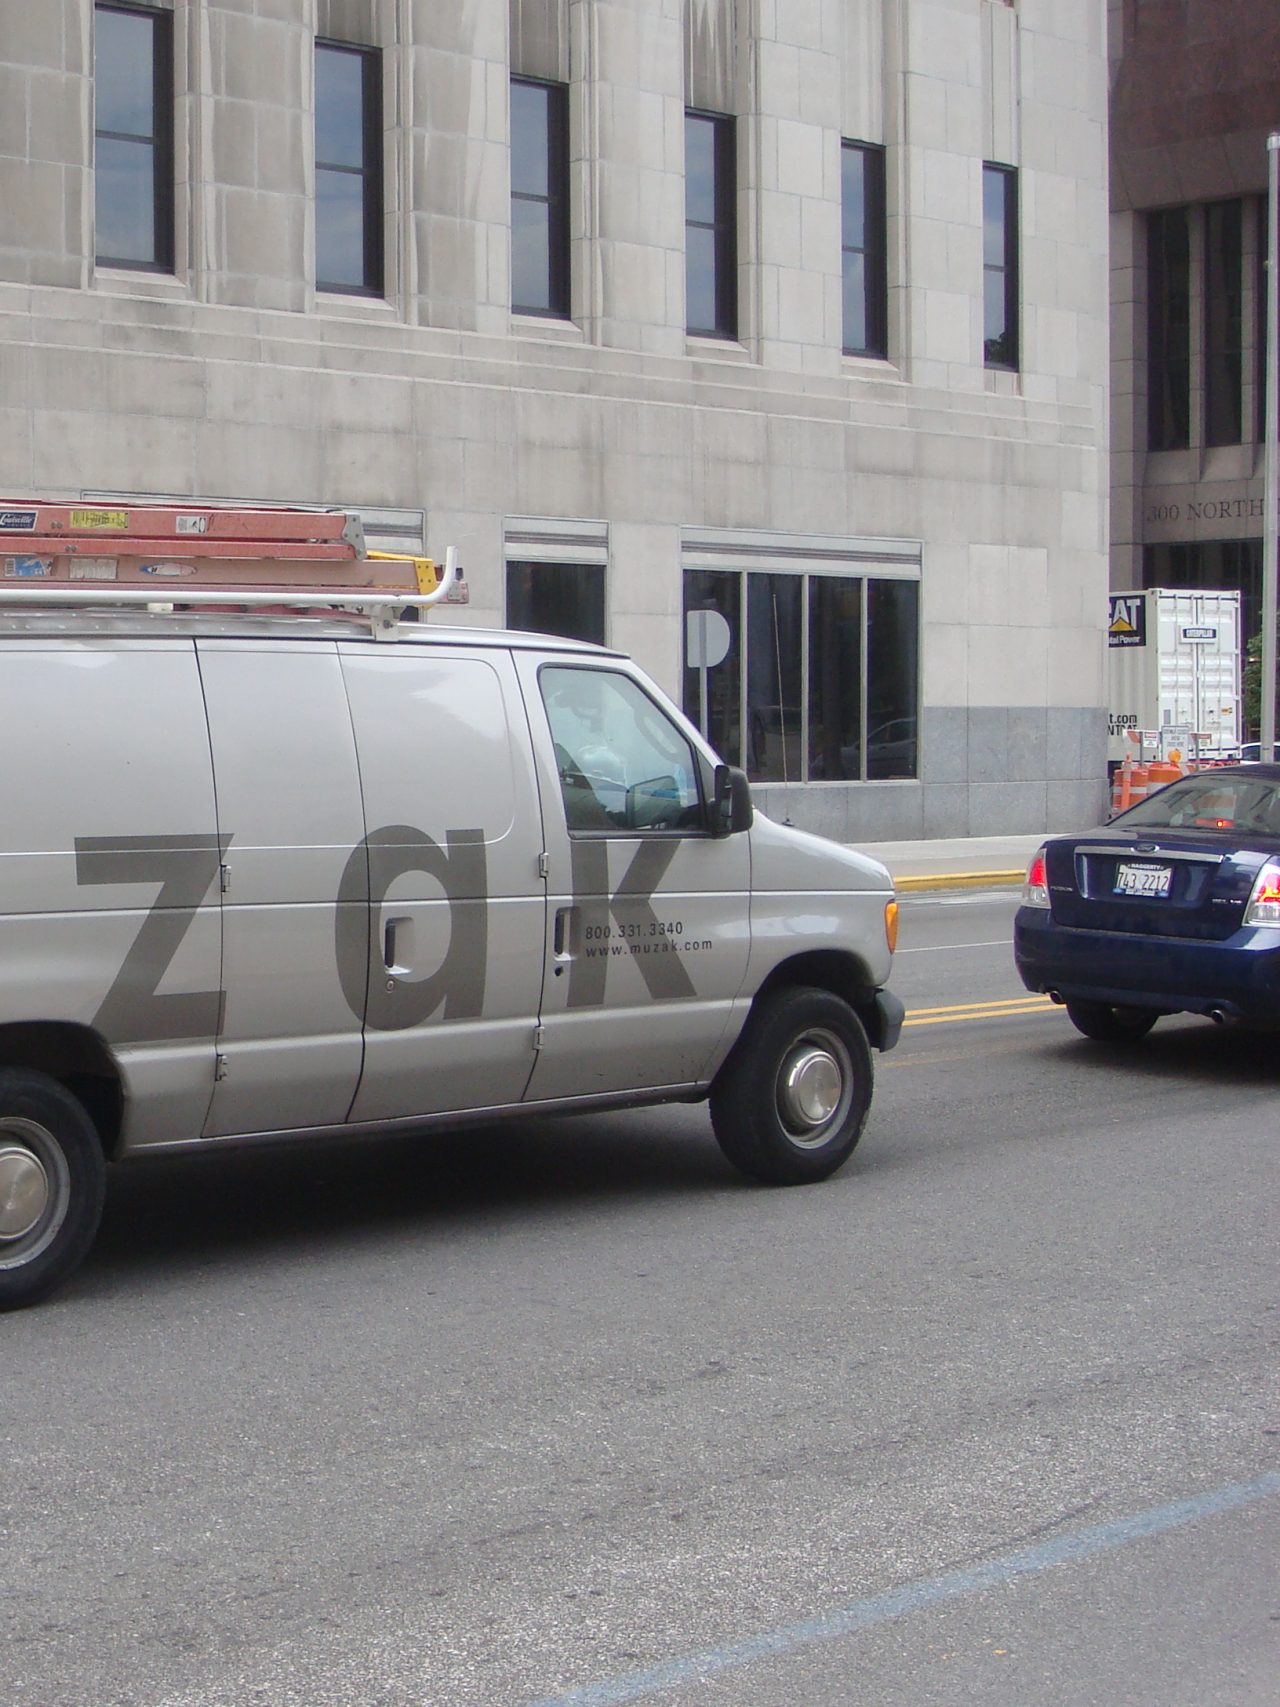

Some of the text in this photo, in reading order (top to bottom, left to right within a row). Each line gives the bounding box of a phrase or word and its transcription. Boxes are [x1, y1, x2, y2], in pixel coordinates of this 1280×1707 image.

[1187, 500, 1264, 521] NORTH
[1109, 599, 1140, 631] AT
[1118, 871, 1169, 891] 743 2212
[586, 921, 683, 940] 800.331.3340
[586, 940, 713, 958] www.muzak.com
